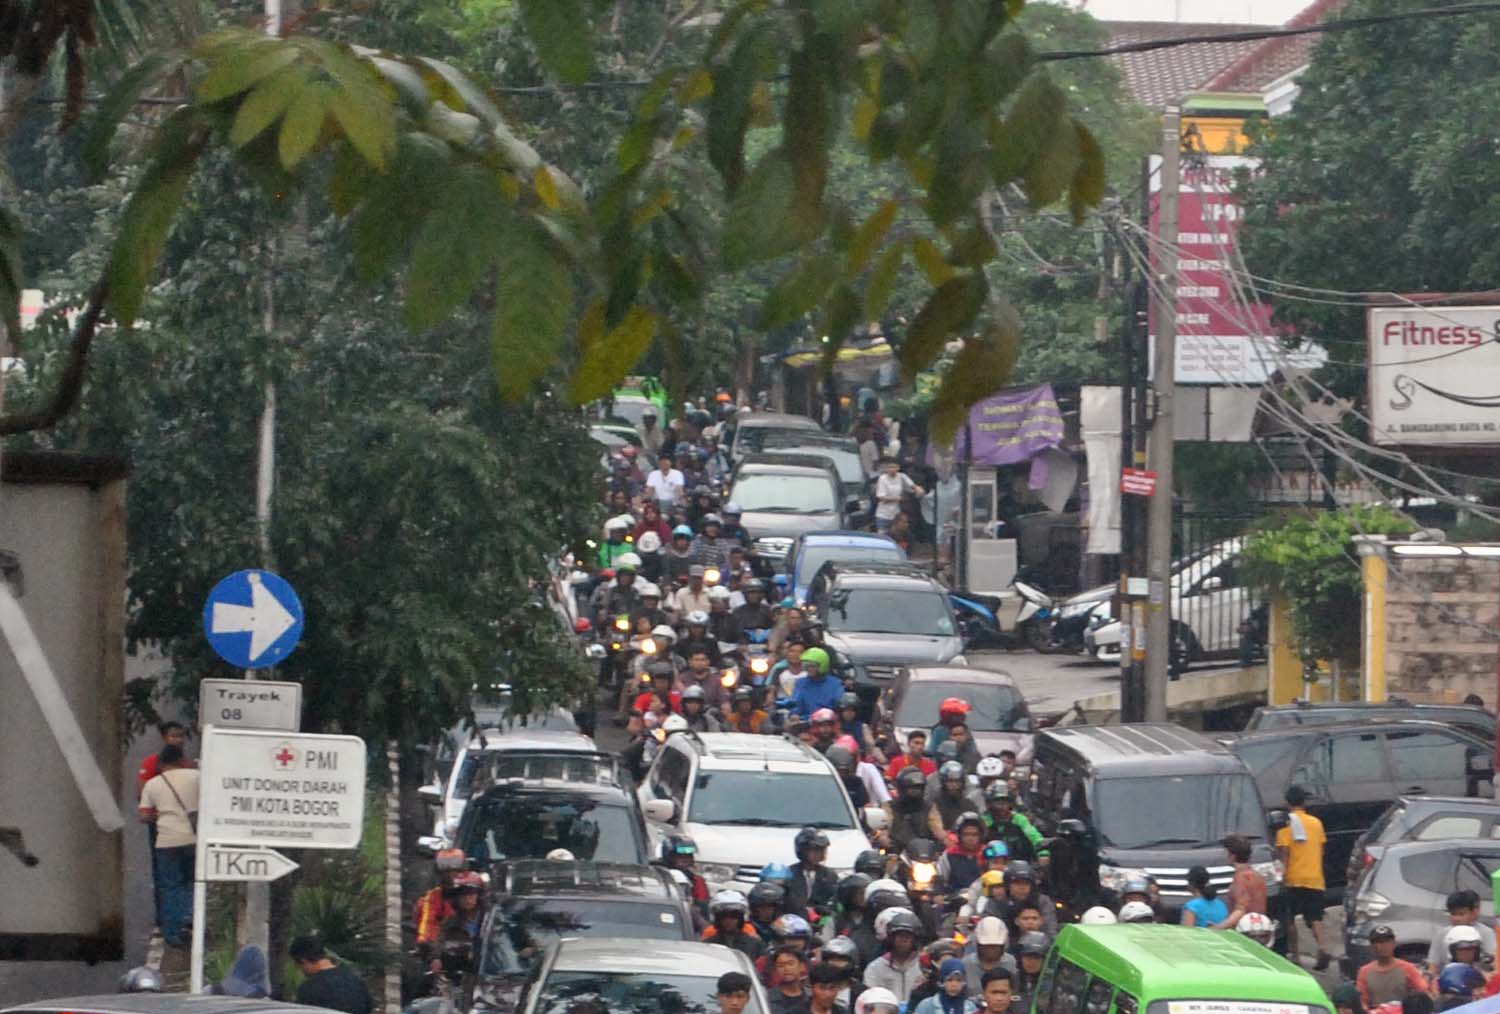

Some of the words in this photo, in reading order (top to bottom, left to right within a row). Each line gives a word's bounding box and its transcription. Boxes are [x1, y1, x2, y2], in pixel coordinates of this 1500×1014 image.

[1383, 321, 1482, 347] Fitness
[216, 689, 281, 703] Trayek
[220, 708, 242, 720] 08
[305, 750, 337, 770] PMI
[222, 777, 251, 790] UNIT
[254, 779, 300, 793] DONOR
[302, 781, 347, 794] DARAH
[231, 797, 254, 812] PMI
[256, 799, 289, 814] KOTA
[292, 801, 340, 816] BOGOR
